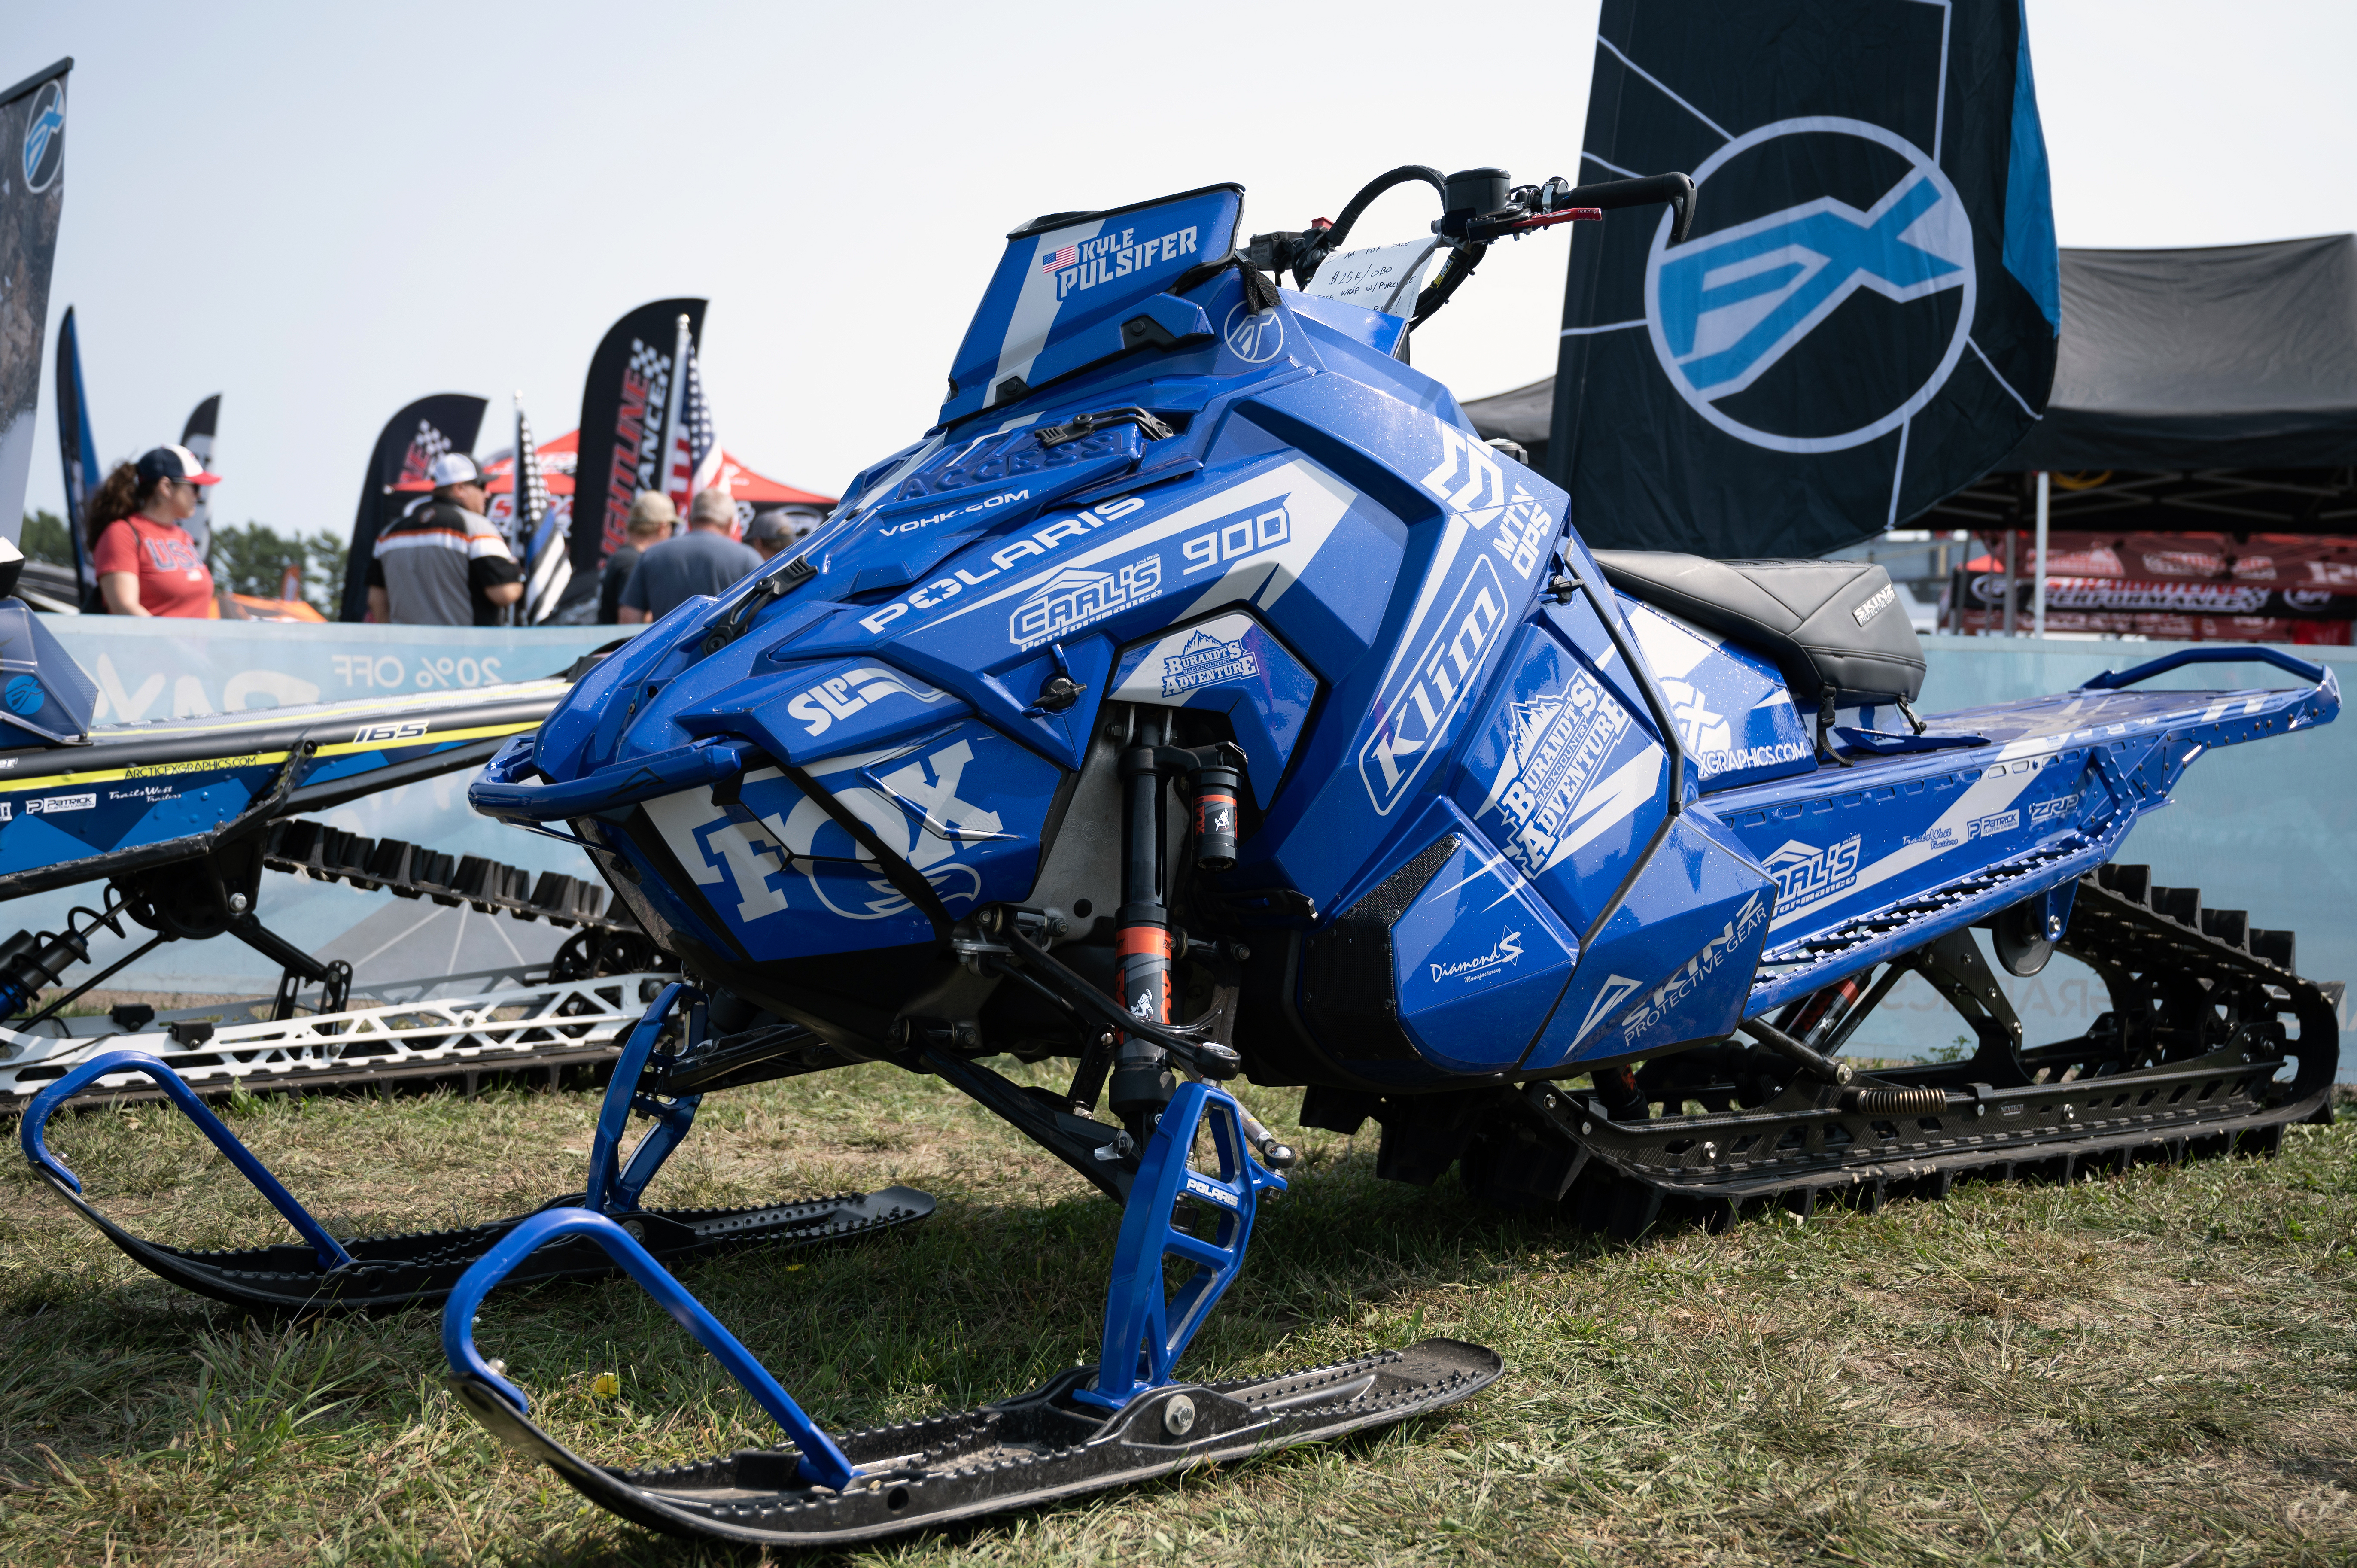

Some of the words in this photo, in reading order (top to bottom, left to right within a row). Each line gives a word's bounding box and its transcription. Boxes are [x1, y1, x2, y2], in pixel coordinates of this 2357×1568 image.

[1059, 226, 1197, 298] PULSIFER
[1082, 228, 1134, 262] KYLE
[1344, 251, 1356, 260] AM
[1341, 287, 1360, 297] WRAP
[879, 489, 1029, 536] VOHK.COM
[1492, 483, 1534, 561] MTN
[1183, 507, 1288, 575] 900
[1512, 503, 1552, 580] OPS
[859, 492, 1146, 634] POLARIS
[1010, 556, 1161, 645] CARL'S
[1019, 589, 1162, 653] performance
[1855, 583, 1894, 619] SKINZ
[1858, 600, 1886, 626] PROTECTIVE
[1164, 655, 1256, 696] ADVENTURE
[1166, 641, 1242, 675] BURANDT'S
[1183, 658, 1231, 674] BACKCOUNTRY
[788, 671, 882, 737] SLP
[354, 719, 430, 744] 165
[1501, 675, 1597, 825] BURANDT'S
[125, 756, 256, 779] ARCTICFXGRAPHICS.COM
[1515, 691, 1630, 871] ADVENTURE
[1536, 718, 1590, 805] BACKCOUNTRY
[146, 793, 182, 803] Trailers
[705, 738, 1004, 923] FOX
[1930, 838, 1958, 850] Trailers
[2000, 821, 2018, 830] CARBON
[1770, 838, 1861, 906] ARL'S
[1772, 875, 1856, 918] formance
[1430, 942, 1500, 983] Diamond
[1464, 967, 1501, 983] Manufacturing
[1621, 890, 1764, 1034] SKINZ
[1625, 952, 1724, 1046] PROTECTIVE
[1726, 906, 1767, 954] GEAR
[1186, 1178, 1239, 1207] POLARIS
